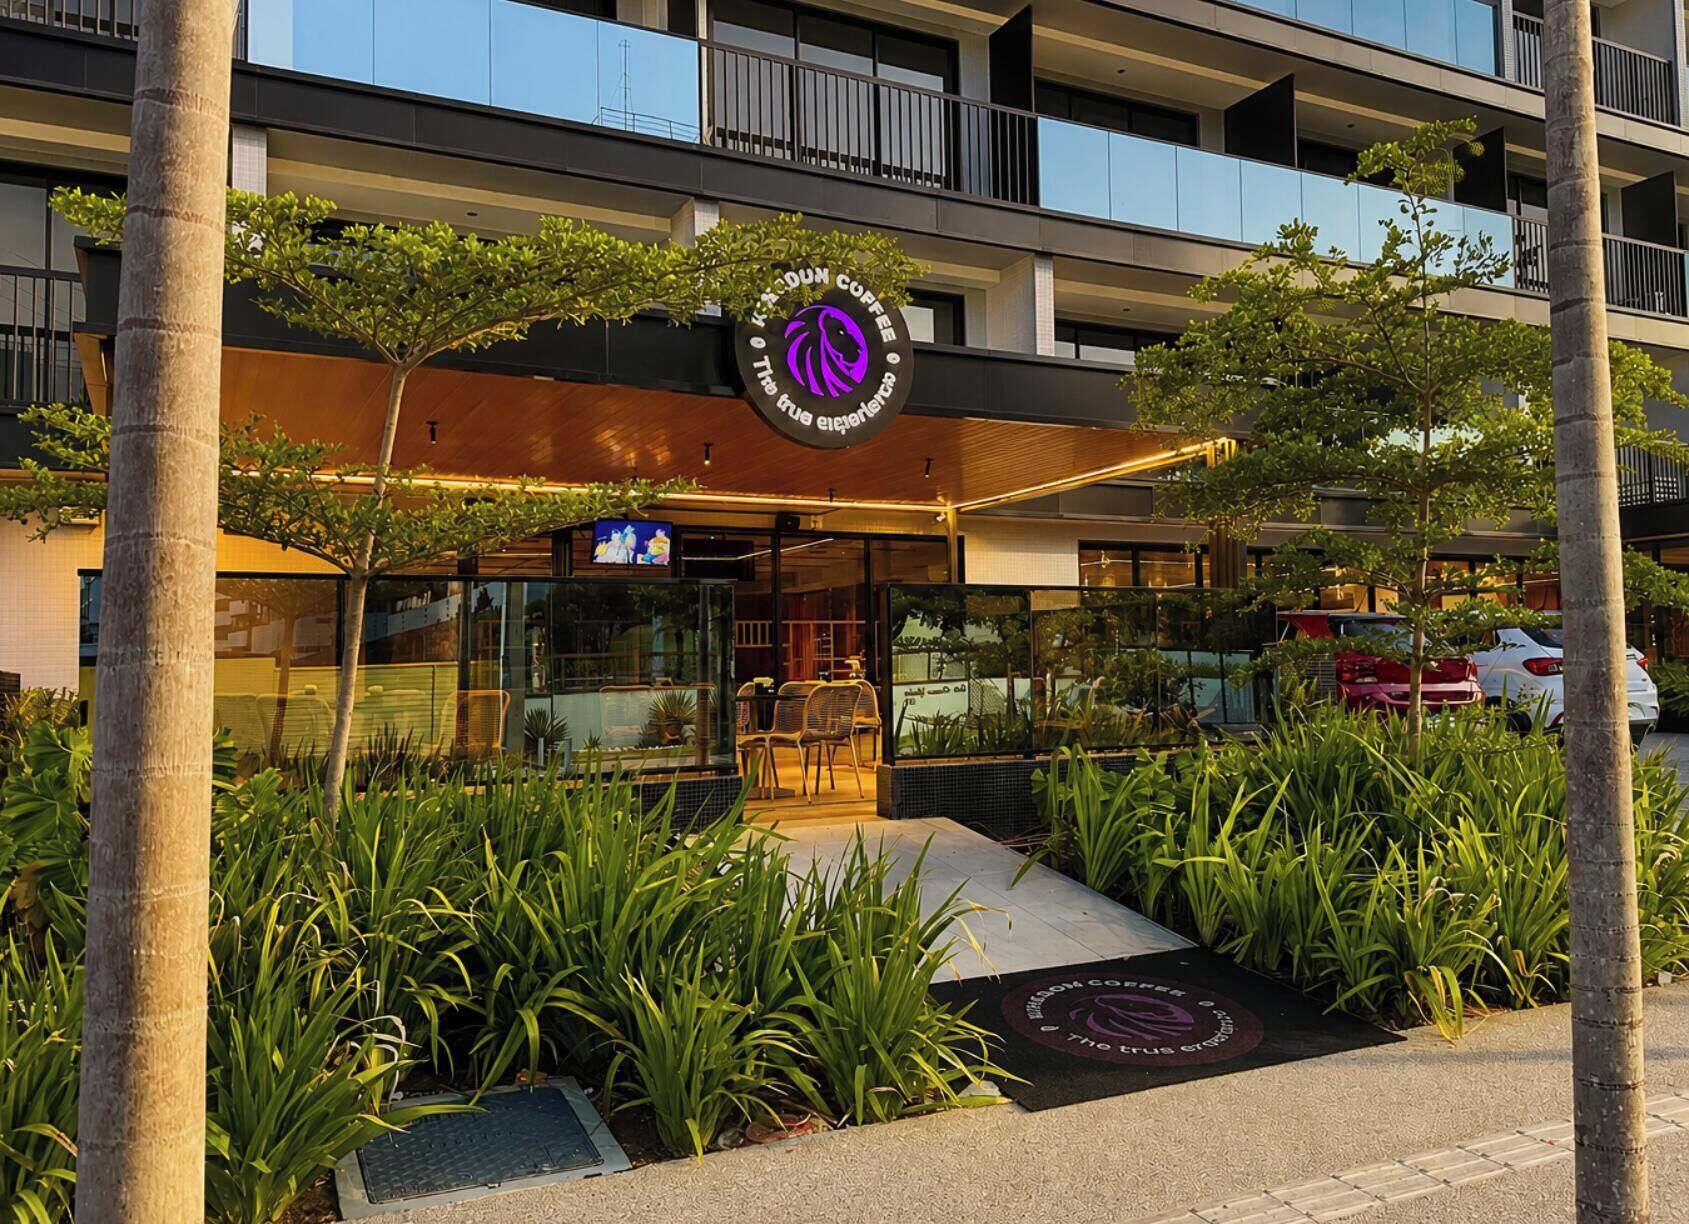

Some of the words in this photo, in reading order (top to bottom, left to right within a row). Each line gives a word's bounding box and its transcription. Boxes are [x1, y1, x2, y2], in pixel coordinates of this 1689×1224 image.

[835, 274, 897, 343] COFFEE
[752, 355, 778, 396] The
[776, 394, 813, 426] true
[1087, 978, 1187, 998] COFFEE
[1066, 1032, 1111, 1052] The
